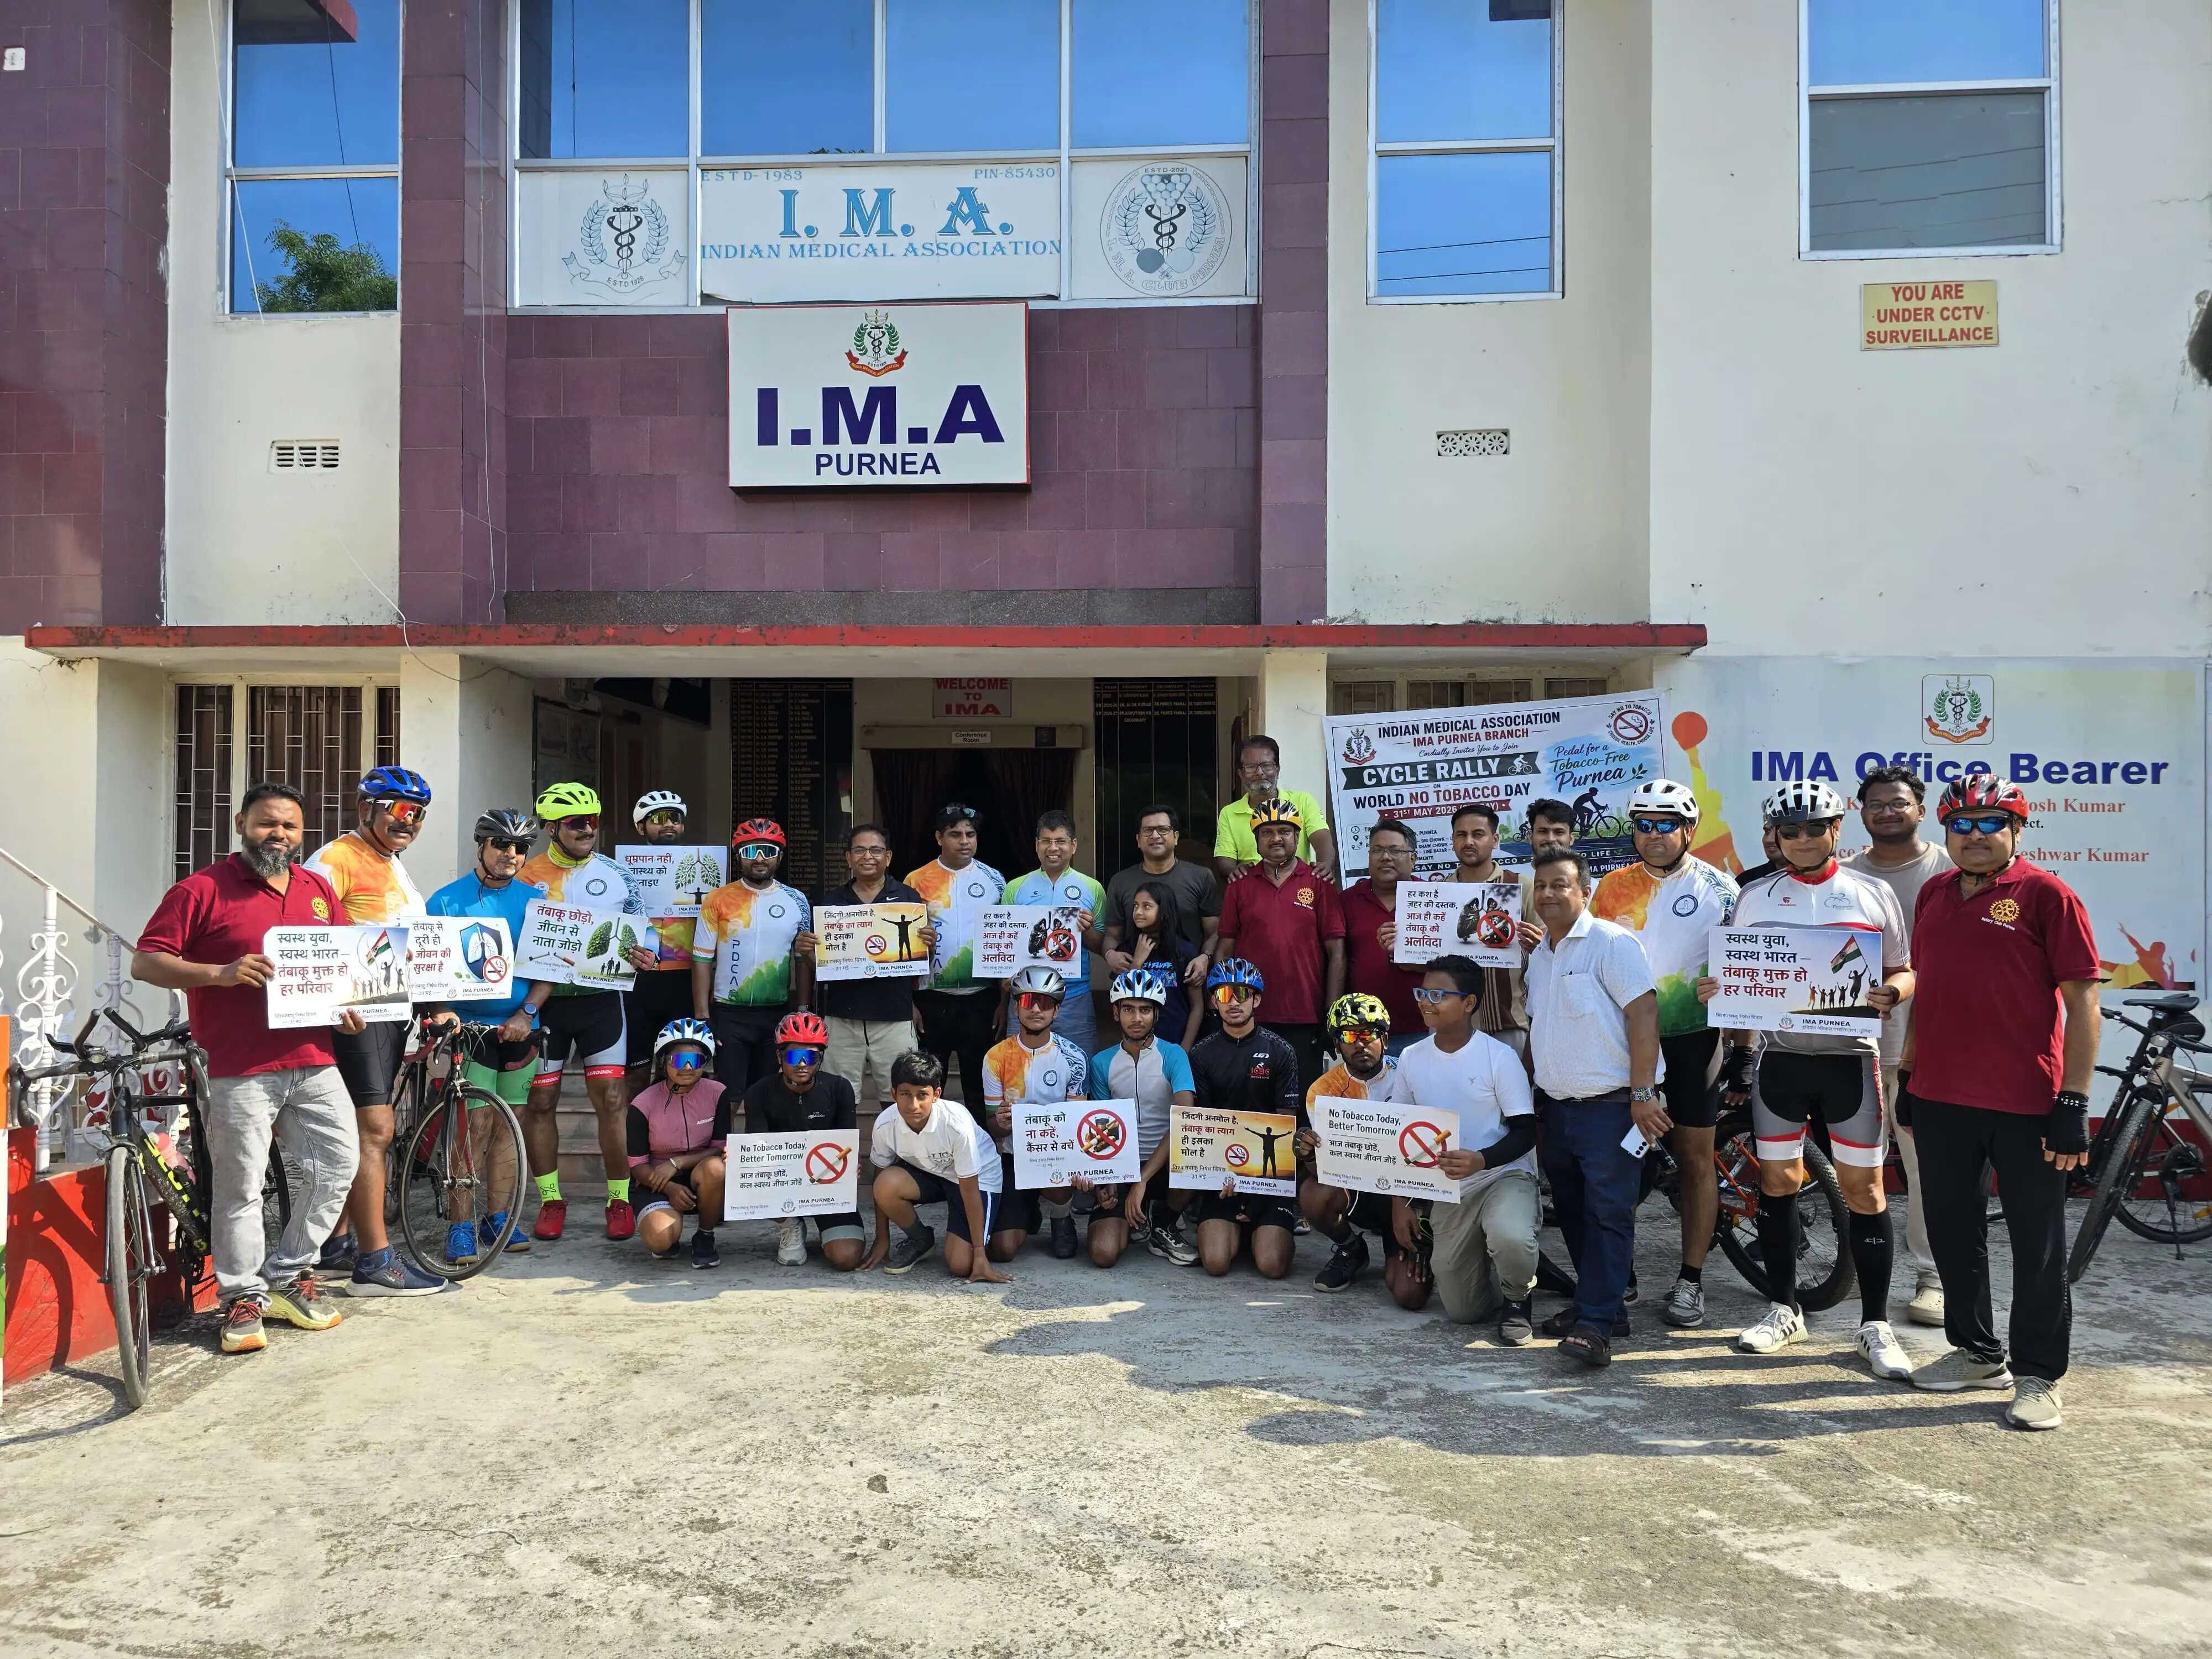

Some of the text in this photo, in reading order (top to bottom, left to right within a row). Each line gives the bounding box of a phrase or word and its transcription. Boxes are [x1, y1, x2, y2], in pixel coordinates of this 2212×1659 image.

[701, 239, 1061, 259] INDIAN MEDICAL ASSOCIATION
[1141, 279, 1188, 291] CLUB
[1190, 237, 1225, 286] PURNEA
[631, 275, 644, 286] 1928
[1891, 283, 1965, 302] YOU ARE
[1876, 305, 1985, 324] UNDER CCTV
[1865, 326, 1994, 345] SURVEILLANCE
[757, 384, 1005, 446] I.M.A
[815, 452, 941, 476] PURNEA
[936, 677, 1009, 690] WELCOME
[964, 692, 983, 701] TO
[945, 703, 1002, 715] IMA
[1608, 710, 1617, 719] SAY
[1632, 704, 1652, 716] TOBACCO
[1378, 711, 1561, 738] INDIAN MEDICAL ASSOCIATION
[1413, 728, 1529, 747] IMA PURNEA BRANCH
[1419, 748, 1450, 758] Cordially
[1451, 746, 1474, 754] Invites
[1477, 745, 1491, 755] You
[1503, 743, 1519, 752] Join
[1554, 743, 1584, 758] Pedal
[1585, 743, 1600, 755] for
[1549, 752, 1631, 772] Tobacco-Free
[1752, 751, 1839, 782] IMA
[2010, 753, 2169, 785] Bearer
[1363, 758, 1500, 785] CYCLE RALLY
[1554, 766, 1627, 793] Purnea
[1353, 782, 1531, 810] WORLD NO TOBACCO DAY
[1413, 807, 1434, 817] MAY
[1435, 804, 1458, 815] 2026
[2063, 799, 2126, 813] Kumar
[2087, 847, 2150, 862] Kumar
[1418, 890, 1432, 899] कश
[1433, 889, 1439, 899] है
[1423, 900, 1434, 909] की
[1435, 901, 1458, 910] दस्तक,
[536, 904, 567, 922] तंबाकू
[1406, 912, 1447, 922] आज ही कहें
[537, 920, 580, 937] जीवन से
[1405, 921, 1439, 935] तंबाकू को
[277, 932, 332, 947] स्वस्थ युवा,
[533, 935, 557, 948] नाता
[1404, 935, 1443, 948] अलविदा
[1725, 933, 1790, 948] स्वस्थ युवा,
[278, 948, 340, 960] स्वस्थ भारत
[1725, 950, 1798, 963] स्वस्थ भारत
[277, 962, 348, 981] तंबाकू मुक्त हो
[1722, 964, 1808, 984] तंबाकू मुक्त हो
[279, 981, 333, 997] हर परिवार
[1723, 983, 1787, 999] हर परिवार
[1024, 1111, 1066, 1126] तंबाकू को
[1204, 1113, 1230, 1123] अनमोल
[1329, 1108, 1401, 1126] No Tobacco Today,
[1025, 1126, 1059, 1139] ना कहें,
[1181, 1124, 1203, 1135] तंबाकू
[1204, 1126, 1215, 1134] का
[1328, 1120, 1397, 1136] Better Tomorrow
[1026, 1139, 1075, 1154] कैंसर से बचें
[1181, 1135, 1213, 1145] ही इसका
[1328, 1139, 1343, 1147] आज
[1344, 1139, 1363, 1152] तंबाकू
[1181, 1147, 1206, 1157] मोल है
[1329, 1149, 1342, 1157] कल
[1344, 1151, 1362, 1160] स्वस्थ
[1364, 1152, 1382, 1163] जीवन
[1408, 1180, 1434, 1188] PURNEA
